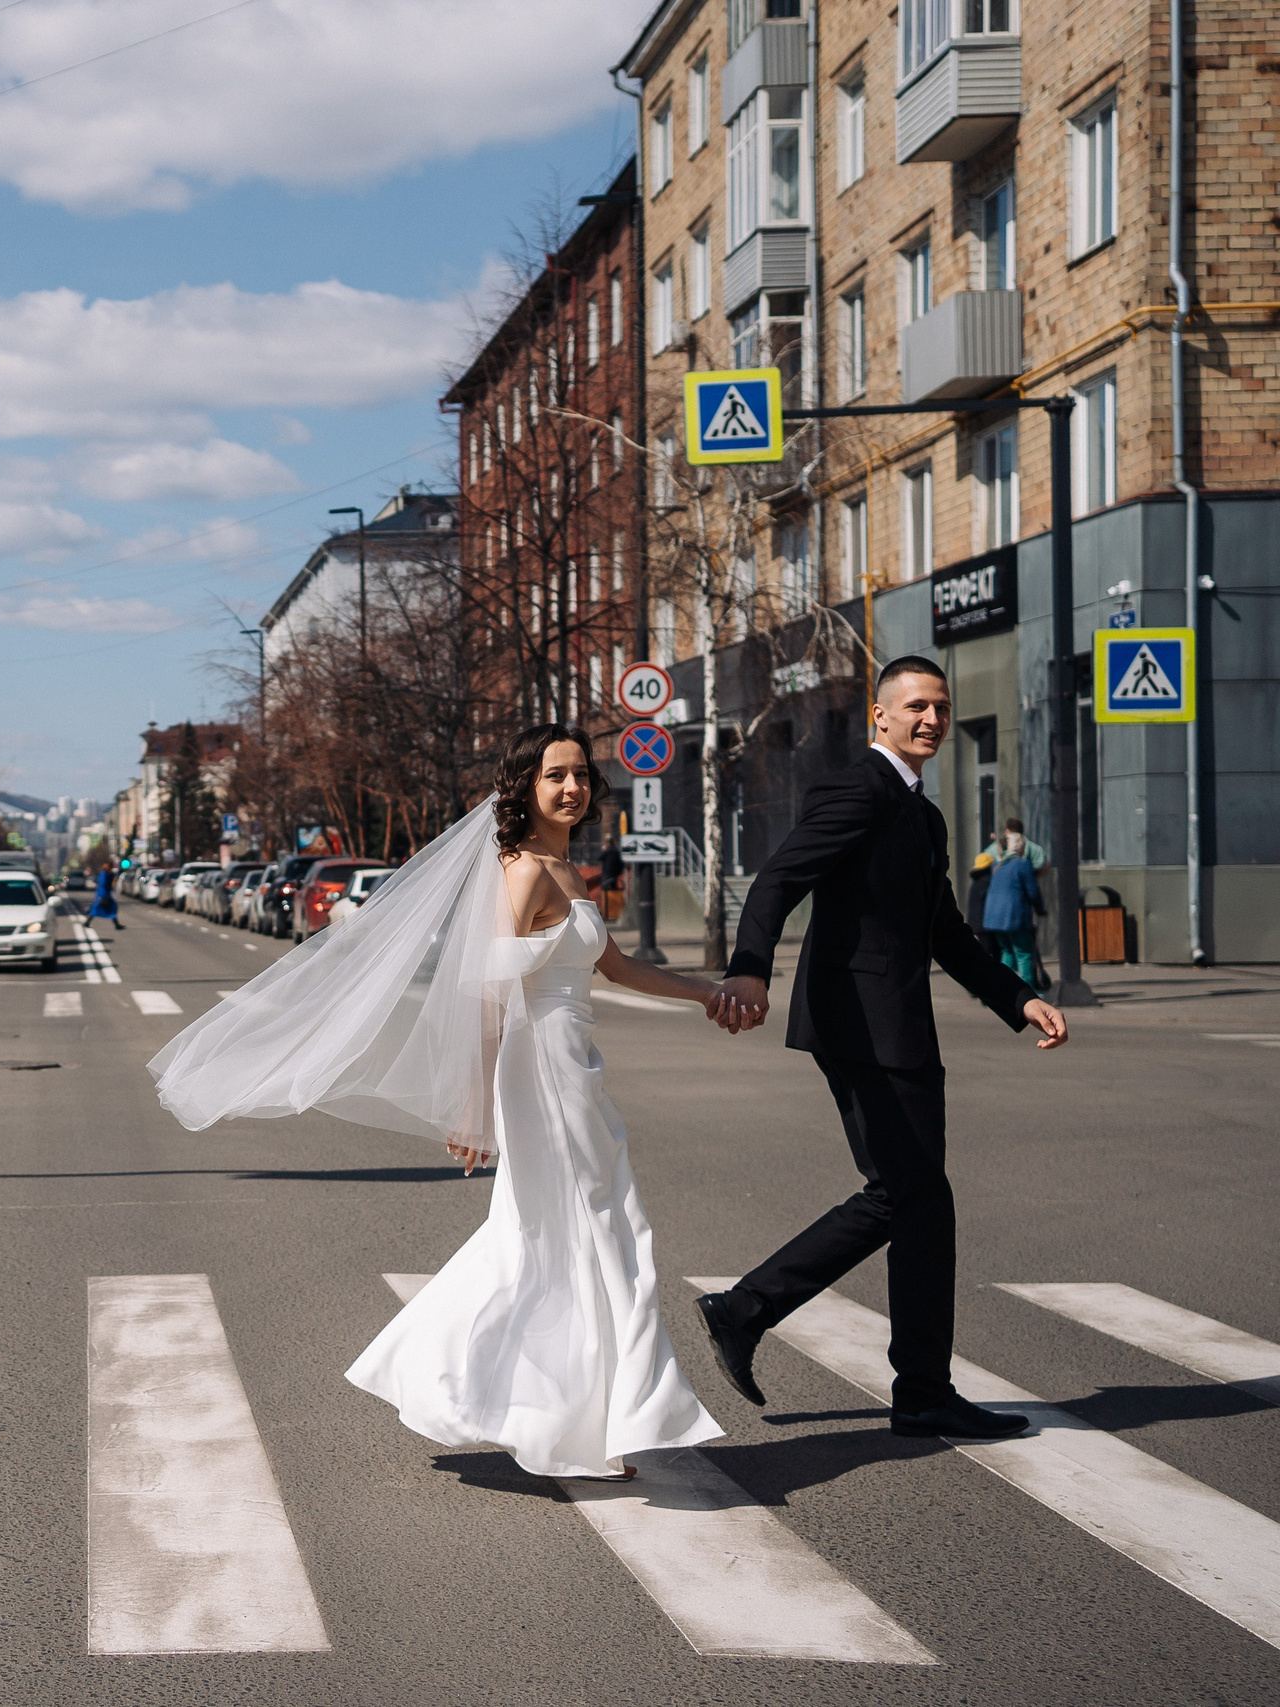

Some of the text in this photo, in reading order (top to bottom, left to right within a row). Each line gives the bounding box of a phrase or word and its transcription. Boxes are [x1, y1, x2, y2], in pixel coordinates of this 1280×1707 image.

[934, 565, 996, 615] ПЕРФЕКТ
[629, 678, 661, 700] 40
[639, 802, 657, 815] 20
